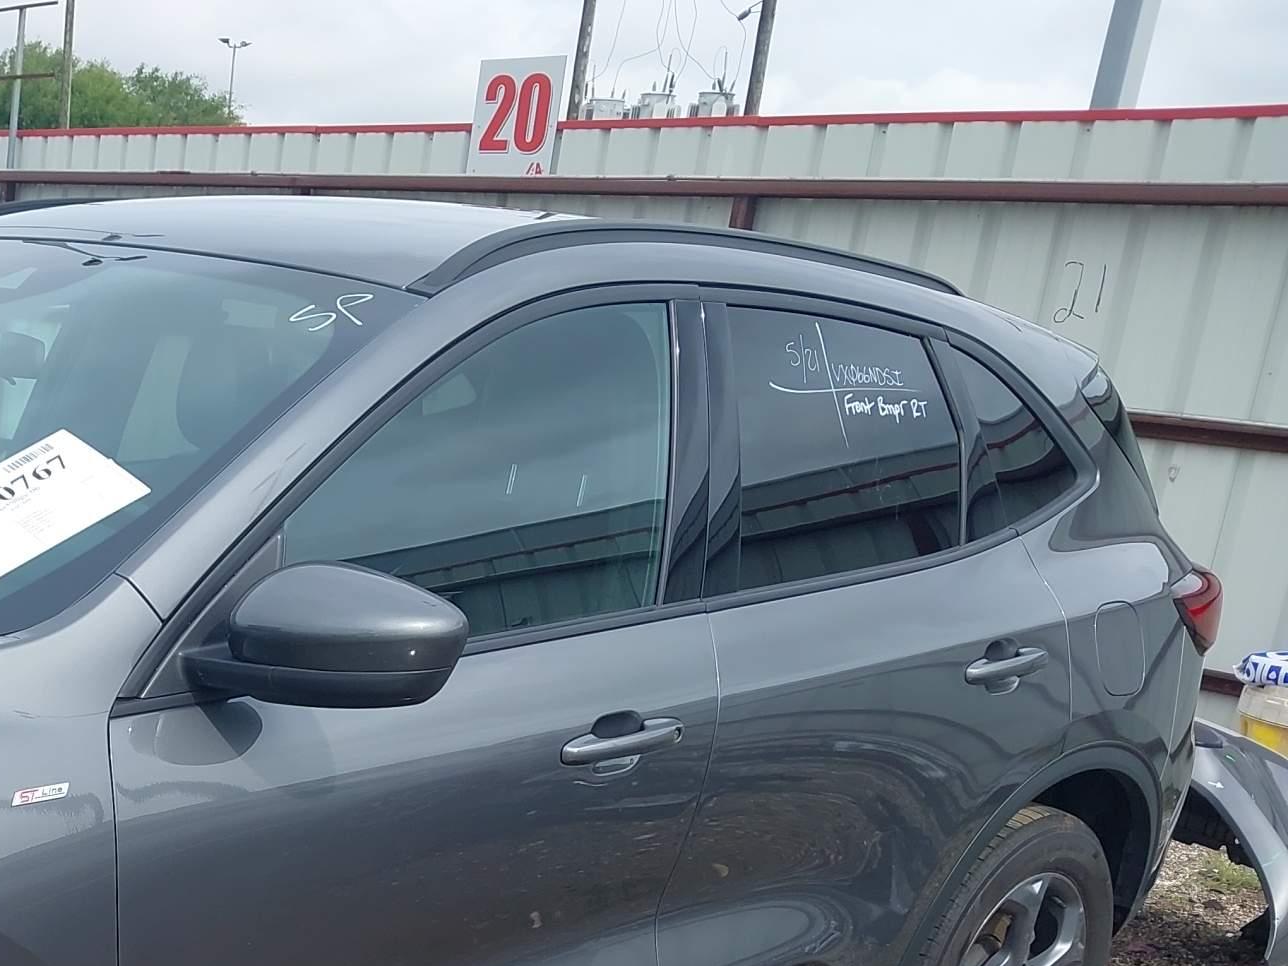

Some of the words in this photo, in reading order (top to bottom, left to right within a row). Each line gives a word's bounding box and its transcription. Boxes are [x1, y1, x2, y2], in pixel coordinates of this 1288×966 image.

[478, 71, 553, 155] 20
[1053, 261, 1107, 324] 21
[785, 334, 821, 384] 5/21
[844, 393, 875, 416] Front
[877, 396, 908, 424] Bmpr
[910, 399, 928, 419] RT
